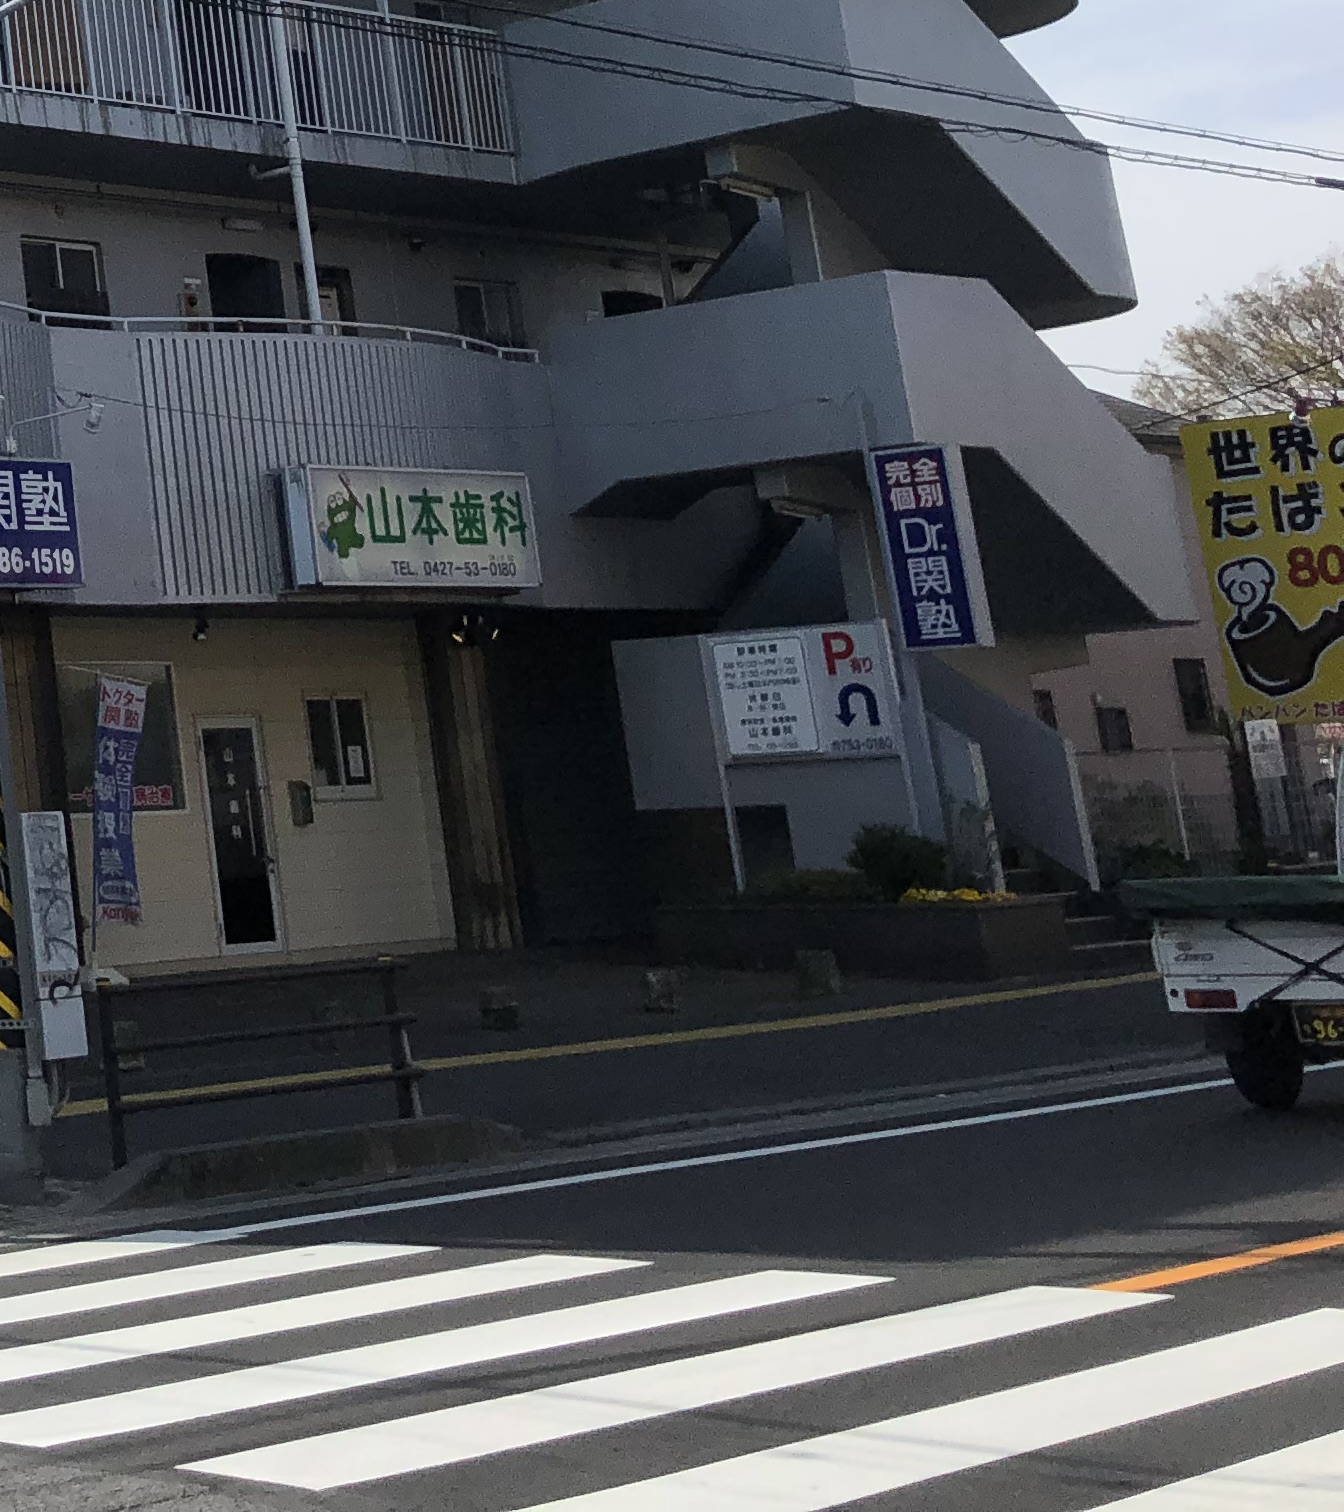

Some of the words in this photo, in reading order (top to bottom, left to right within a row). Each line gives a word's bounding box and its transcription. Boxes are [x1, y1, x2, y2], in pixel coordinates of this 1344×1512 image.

[884, 457, 940, 486] 完全
[365, 485, 529, 548] 山本歯科
[889, 483, 943, 511] 個別
[901, 518, 949, 555] Dr.
[906, 557, 963, 642] 関塾
[821, 631, 855, 677] P
